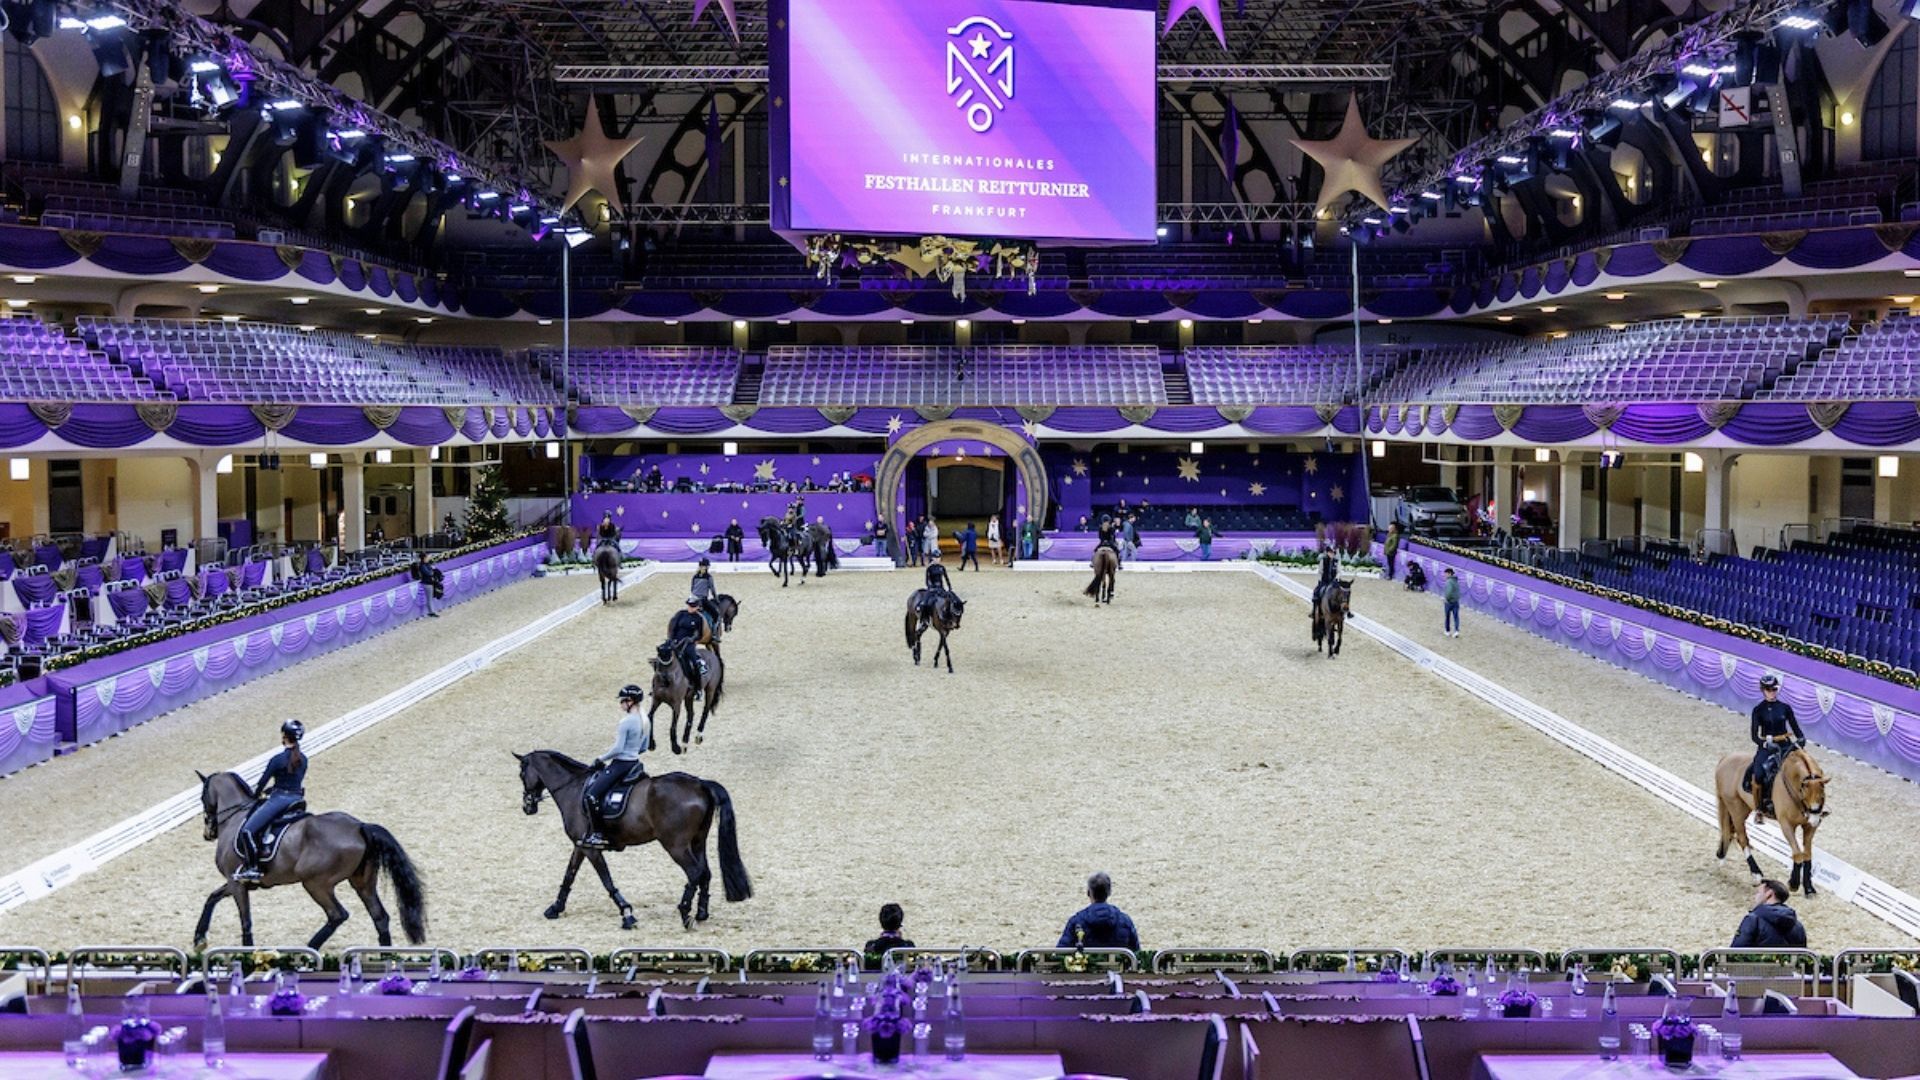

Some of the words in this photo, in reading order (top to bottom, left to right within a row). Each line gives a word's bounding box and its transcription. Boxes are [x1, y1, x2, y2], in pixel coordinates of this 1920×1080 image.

[903, 153, 1054, 170] INTERNATIONALES
[865, 174, 974, 193] FESTHALLEN
[978, 180, 1090, 198] REITTURNIER
[932, 204, 1026, 218] FRANKFURT
[1387, 332, 1411, 344] Bar
